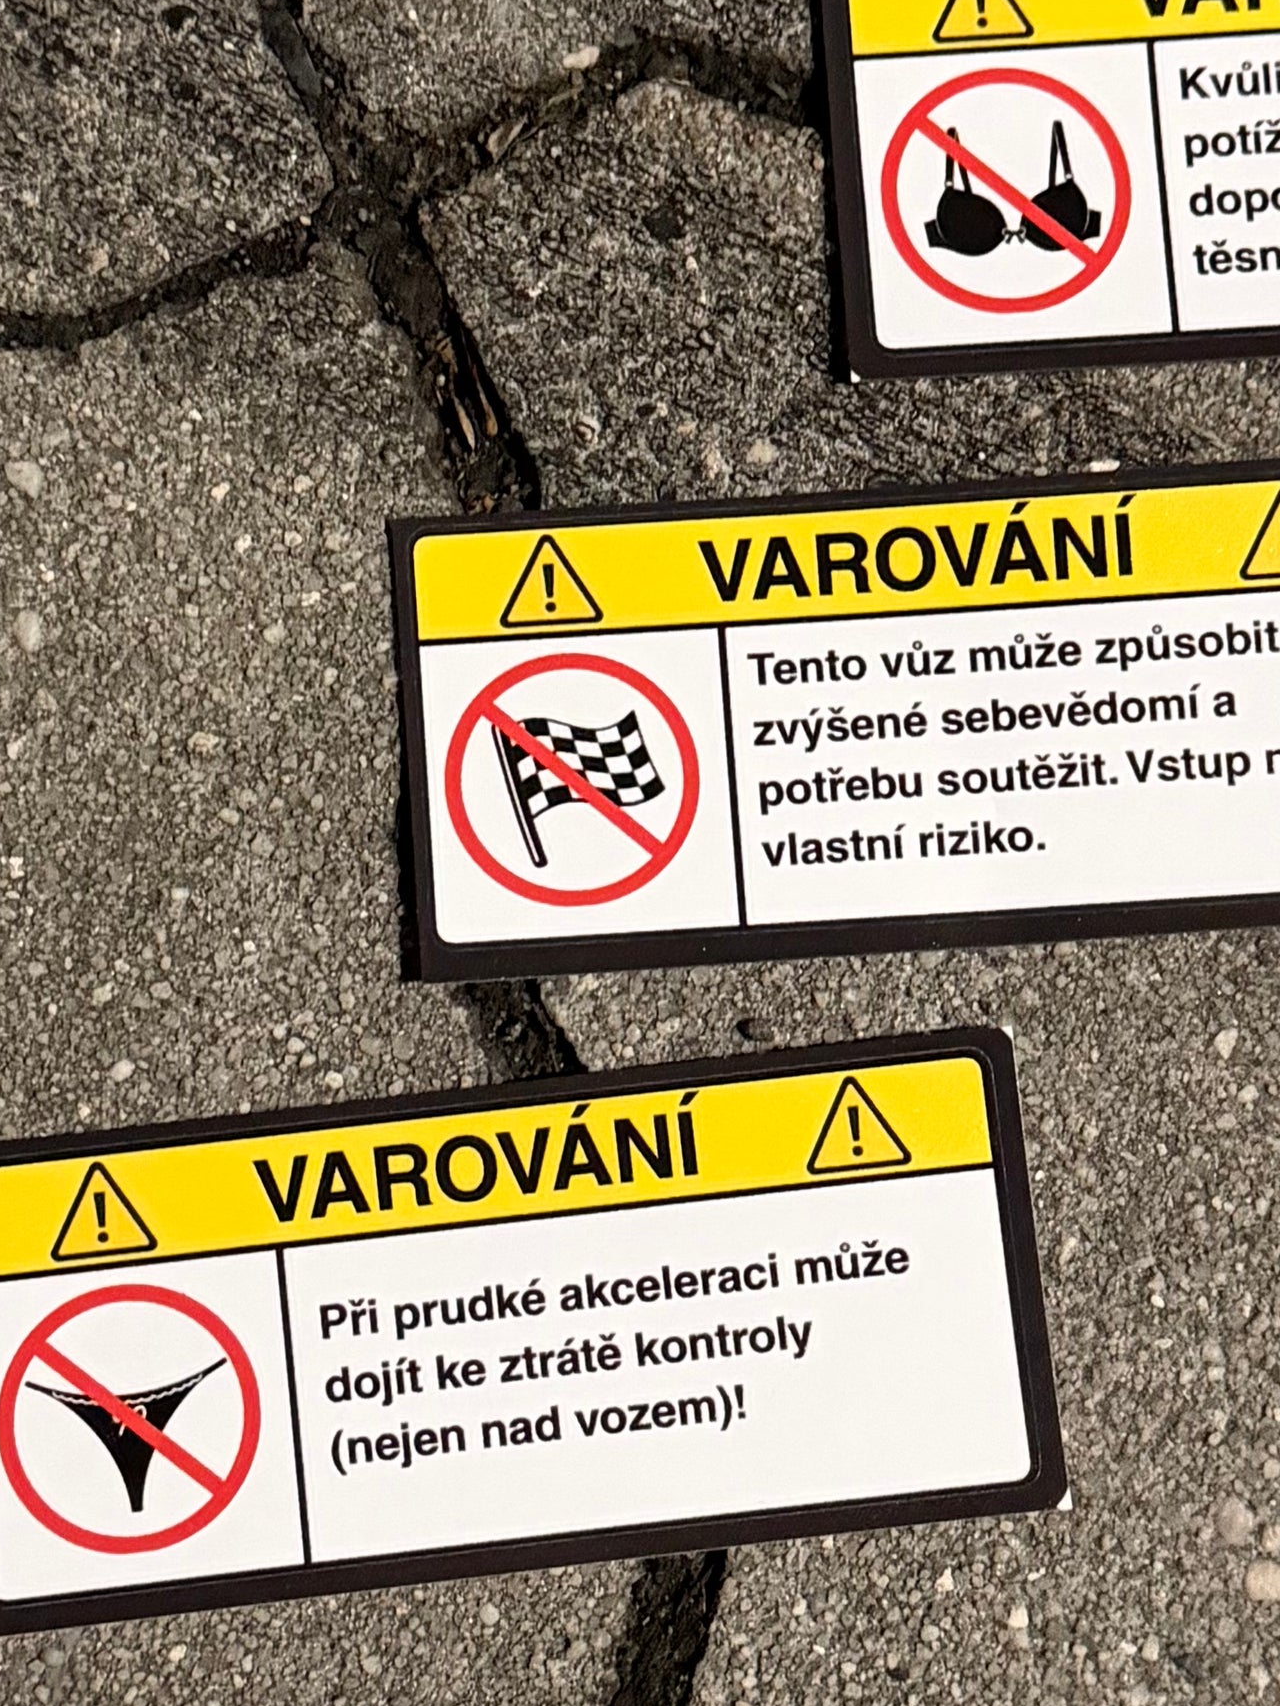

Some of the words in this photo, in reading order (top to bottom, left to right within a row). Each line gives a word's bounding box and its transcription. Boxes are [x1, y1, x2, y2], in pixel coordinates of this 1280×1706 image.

[697, 493, 1136, 602] VAROVÁNÍ
[746, 649, 867, 686] Tento
[880, 640, 956, 678] vůz
[968, 632, 1082, 673] může
[1095, 620, 1280, 672] způsobit
[753, 701, 928, 753] zvýšené
[941, 683, 1201, 736] sebevědomí
[1213, 691, 1237, 718] a
[758, 766, 923, 816] potřebu
[937, 752, 1119, 796] soutěžit.
[1125, 748, 1251, 787] Vstup
[761, 823, 906, 867] vlastní
[918, 820, 1046, 858] riziko.
[252, 1090, 699, 1223] VAROVÁNÍ
[319, 1298, 379, 1340] Při
[393, 1278, 546, 1341] prudké
[559, 1252, 780, 1312] akceleraci
[794, 1239, 910, 1285] může
[325, 1356, 424, 1407] dojít
[435, 1354, 487, 1390] ke
[499, 1332, 622, 1383] ztrátě
[634, 1315, 812, 1367] kontroly
[331, 1422, 466, 1476] (nejen
[481, 1405, 562, 1449] nad
[574, 1384, 746, 1437] vozem)!
